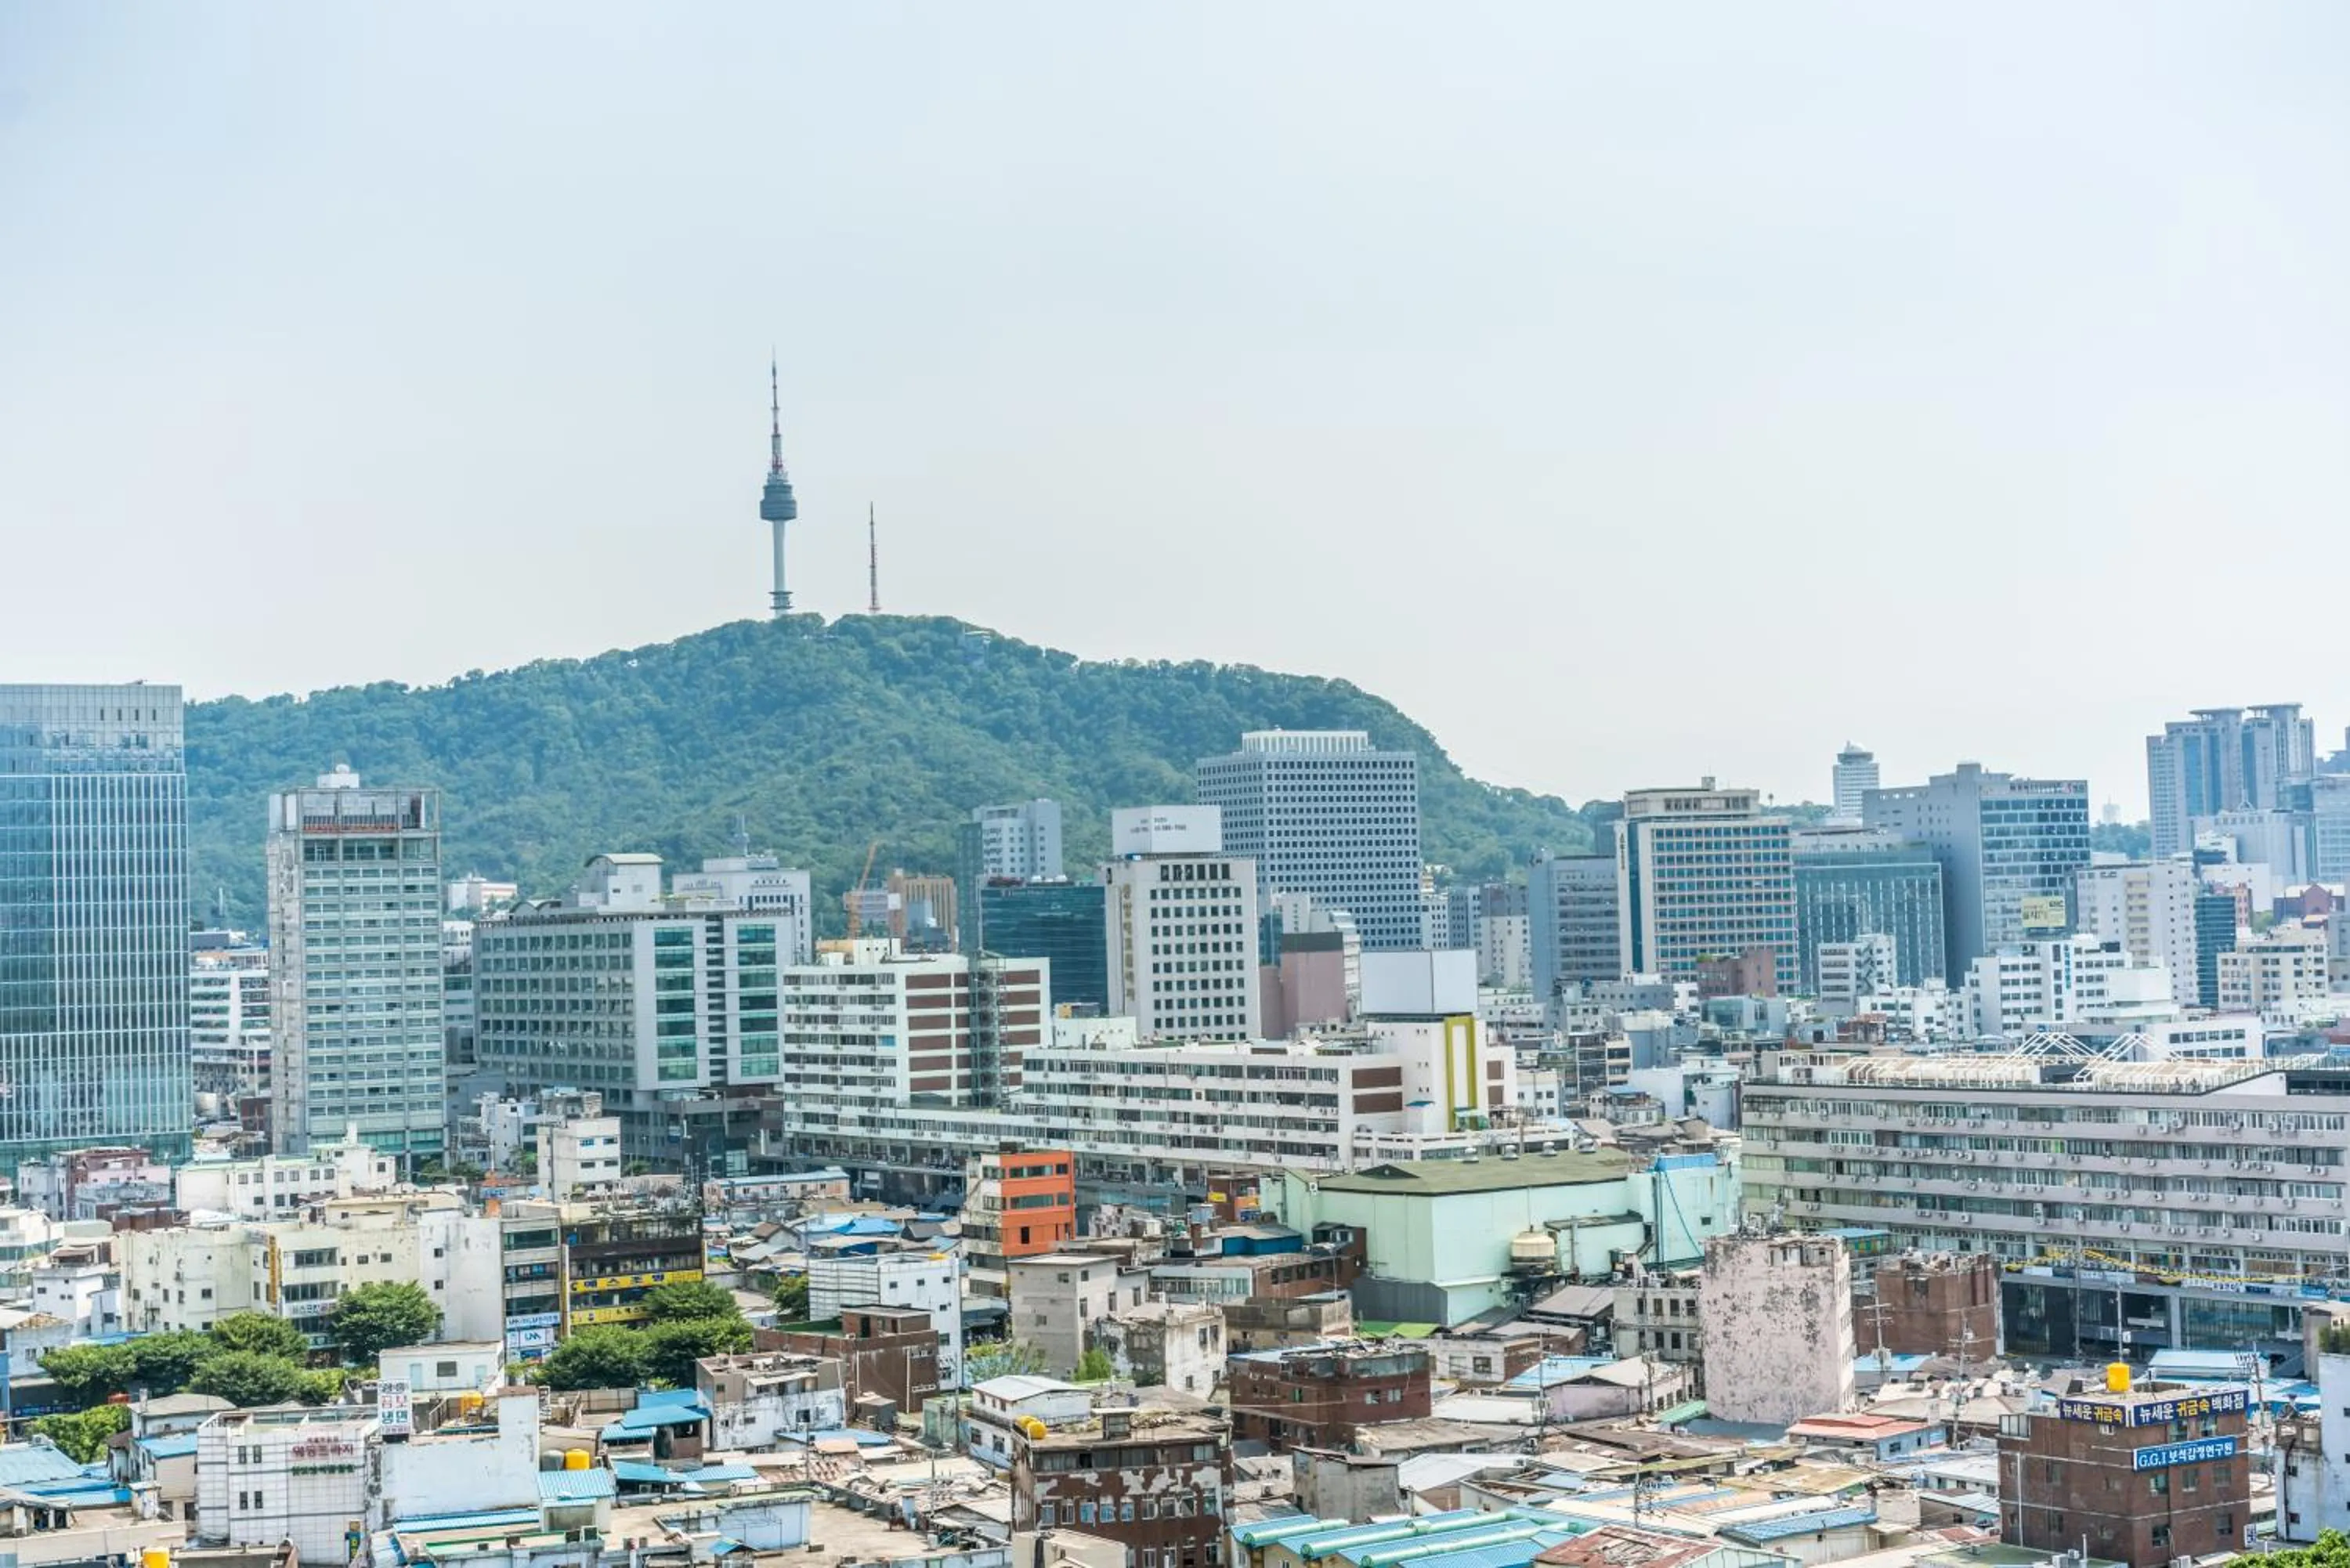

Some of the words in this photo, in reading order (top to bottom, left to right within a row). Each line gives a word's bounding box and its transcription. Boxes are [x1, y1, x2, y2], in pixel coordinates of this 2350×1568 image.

[2063, 1403, 2092, 1421] 뉴세운
[2094, 1405, 2124, 1423] 귀금속
[2139, 1403, 2174, 1423] 뉴세운
[2176, 1399, 2210, 1417] 귀금속
[2211, 1394, 2244, 1411] 백화점
[2138, 1453, 2167, 1467] G.G.I
[2168, 1442, 2232, 1464] 보석감정연구원
